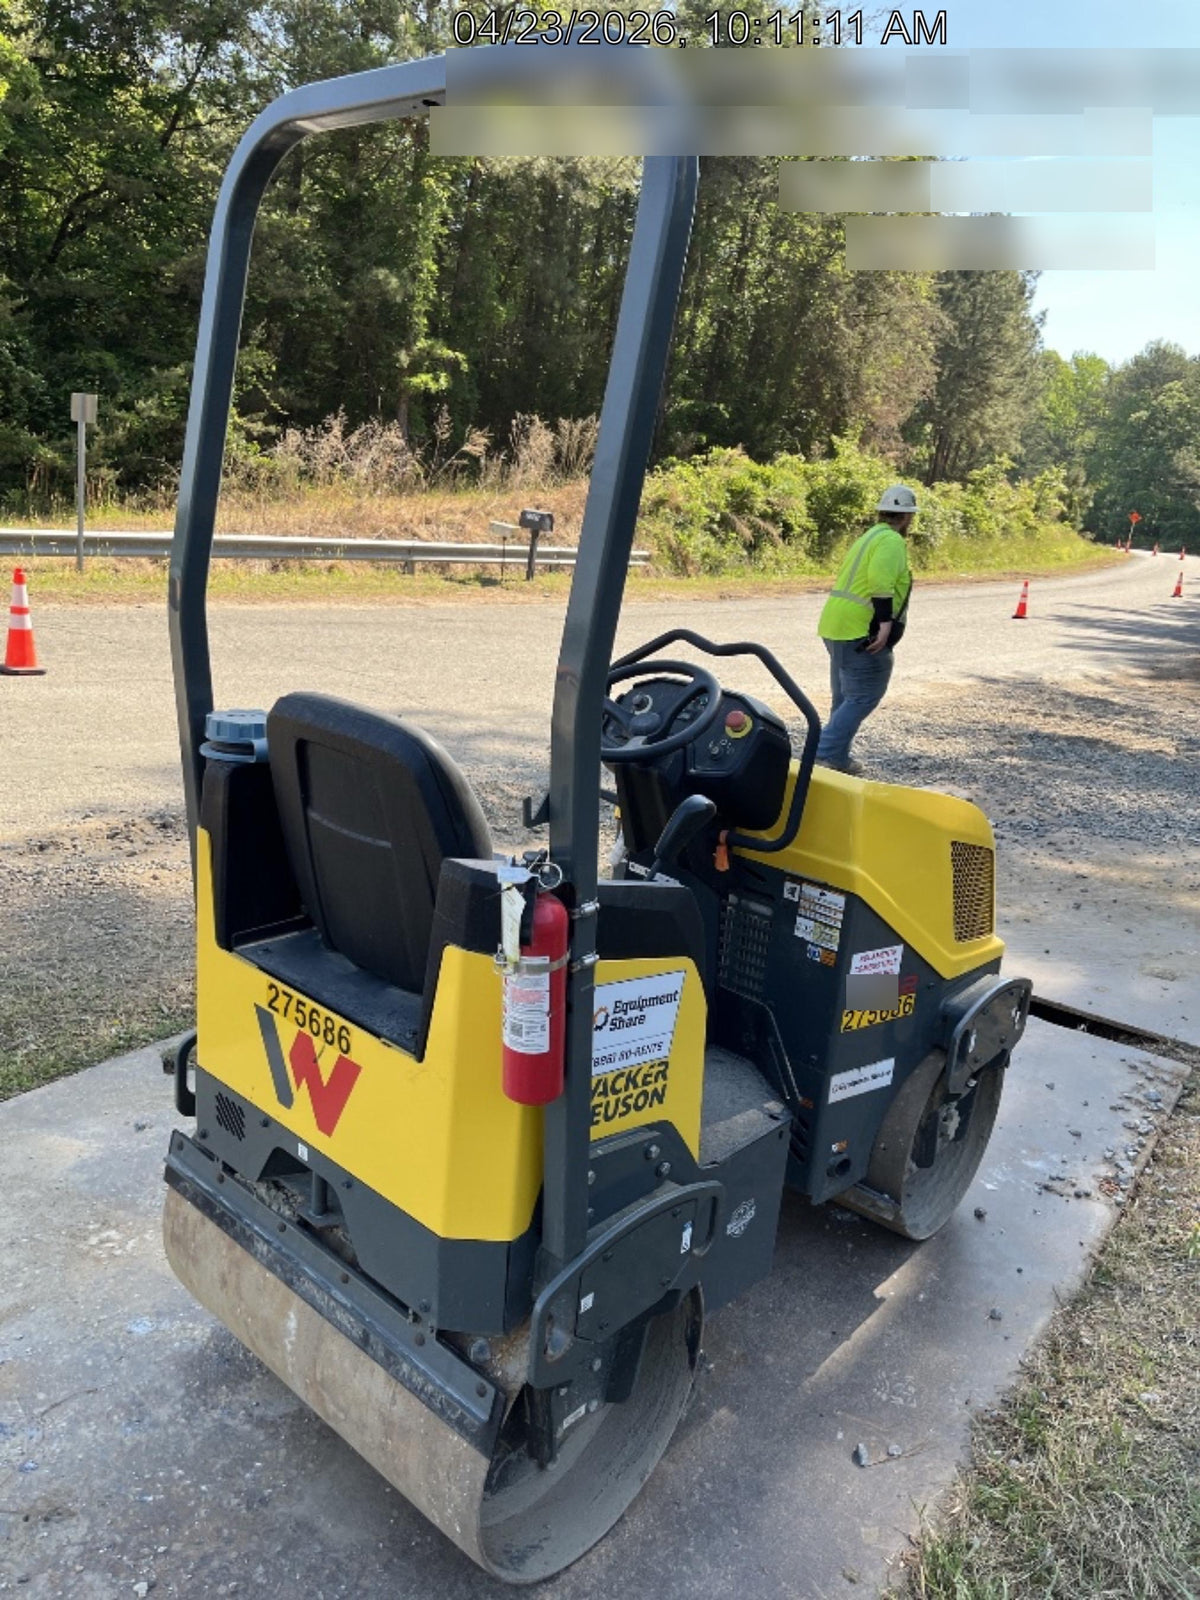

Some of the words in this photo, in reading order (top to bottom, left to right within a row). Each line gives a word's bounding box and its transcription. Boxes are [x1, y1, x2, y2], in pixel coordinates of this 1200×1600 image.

[266, 983, 352, 1055] 275686
[613, 990, 679, 1015] Equipment
[609, 1013, 647, 1032] Share
[591, 1084, 667, 1126] EUSON
